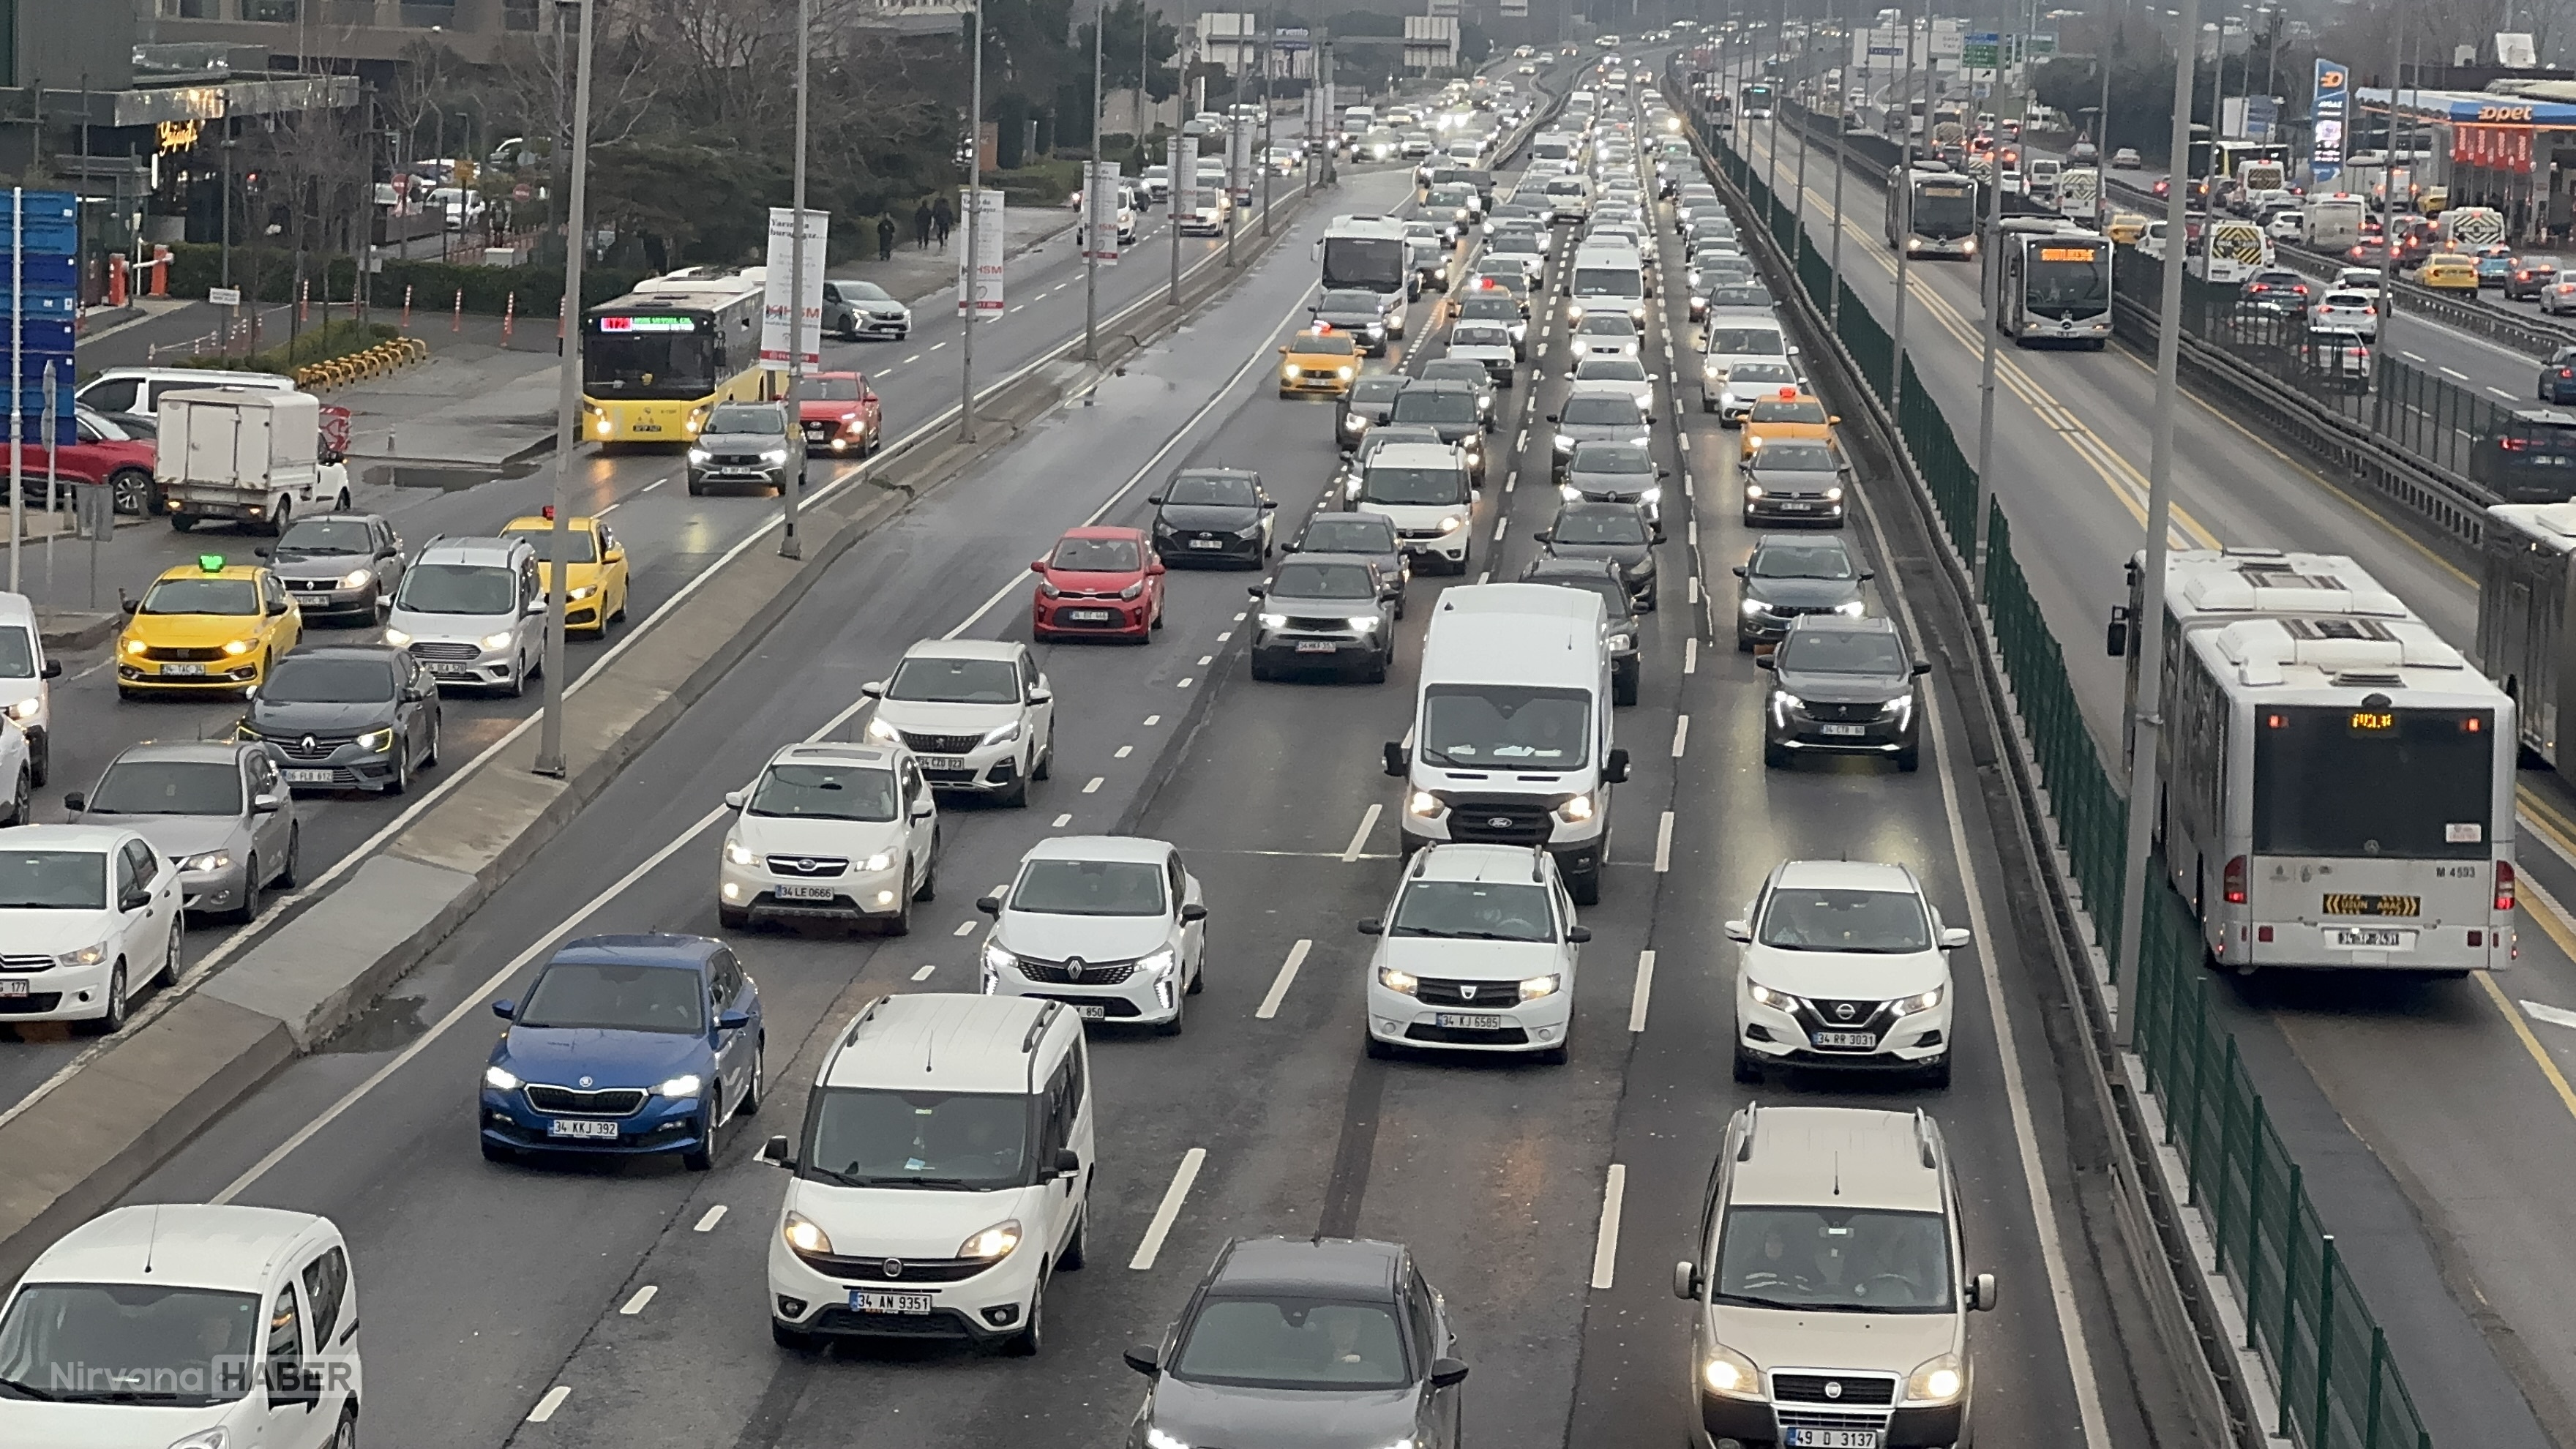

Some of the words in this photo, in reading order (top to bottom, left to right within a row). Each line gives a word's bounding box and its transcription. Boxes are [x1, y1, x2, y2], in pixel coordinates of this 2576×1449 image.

[782, 888, 793, 896] 34
[795, 888, 807, 896] LE
[809, 888, 831, 897] 0666
[12, 982, 26, 992] 177
[1086, 1007, 1103, 1017] 850
[1443, 1016, 1454, 1025] 34
[1459, 1016, 1471, 1027] KJ
[1475, 1017, 1498, 1028] 6585
[1819, 1033, 1830, 1043] 34
[1834, 1034, 1846, 1044] RR
[1850, 1035, 1873, 1045] 3031
[555, 1121, 567, 1132] 34
[573, 1122, 592, 1134] KKJ
[597, 1123, 615, 1135] 392
[858, 1295, 872, 1307] 34
[880, 1295, 894, 1308] AN
[899, 1296, 927, 1310] 9351
[1797, 1431, 1813, 1445] 49
[1823, 1431, 1831, 1446] D
[1841, 1432, 1873, 1447] 3137
